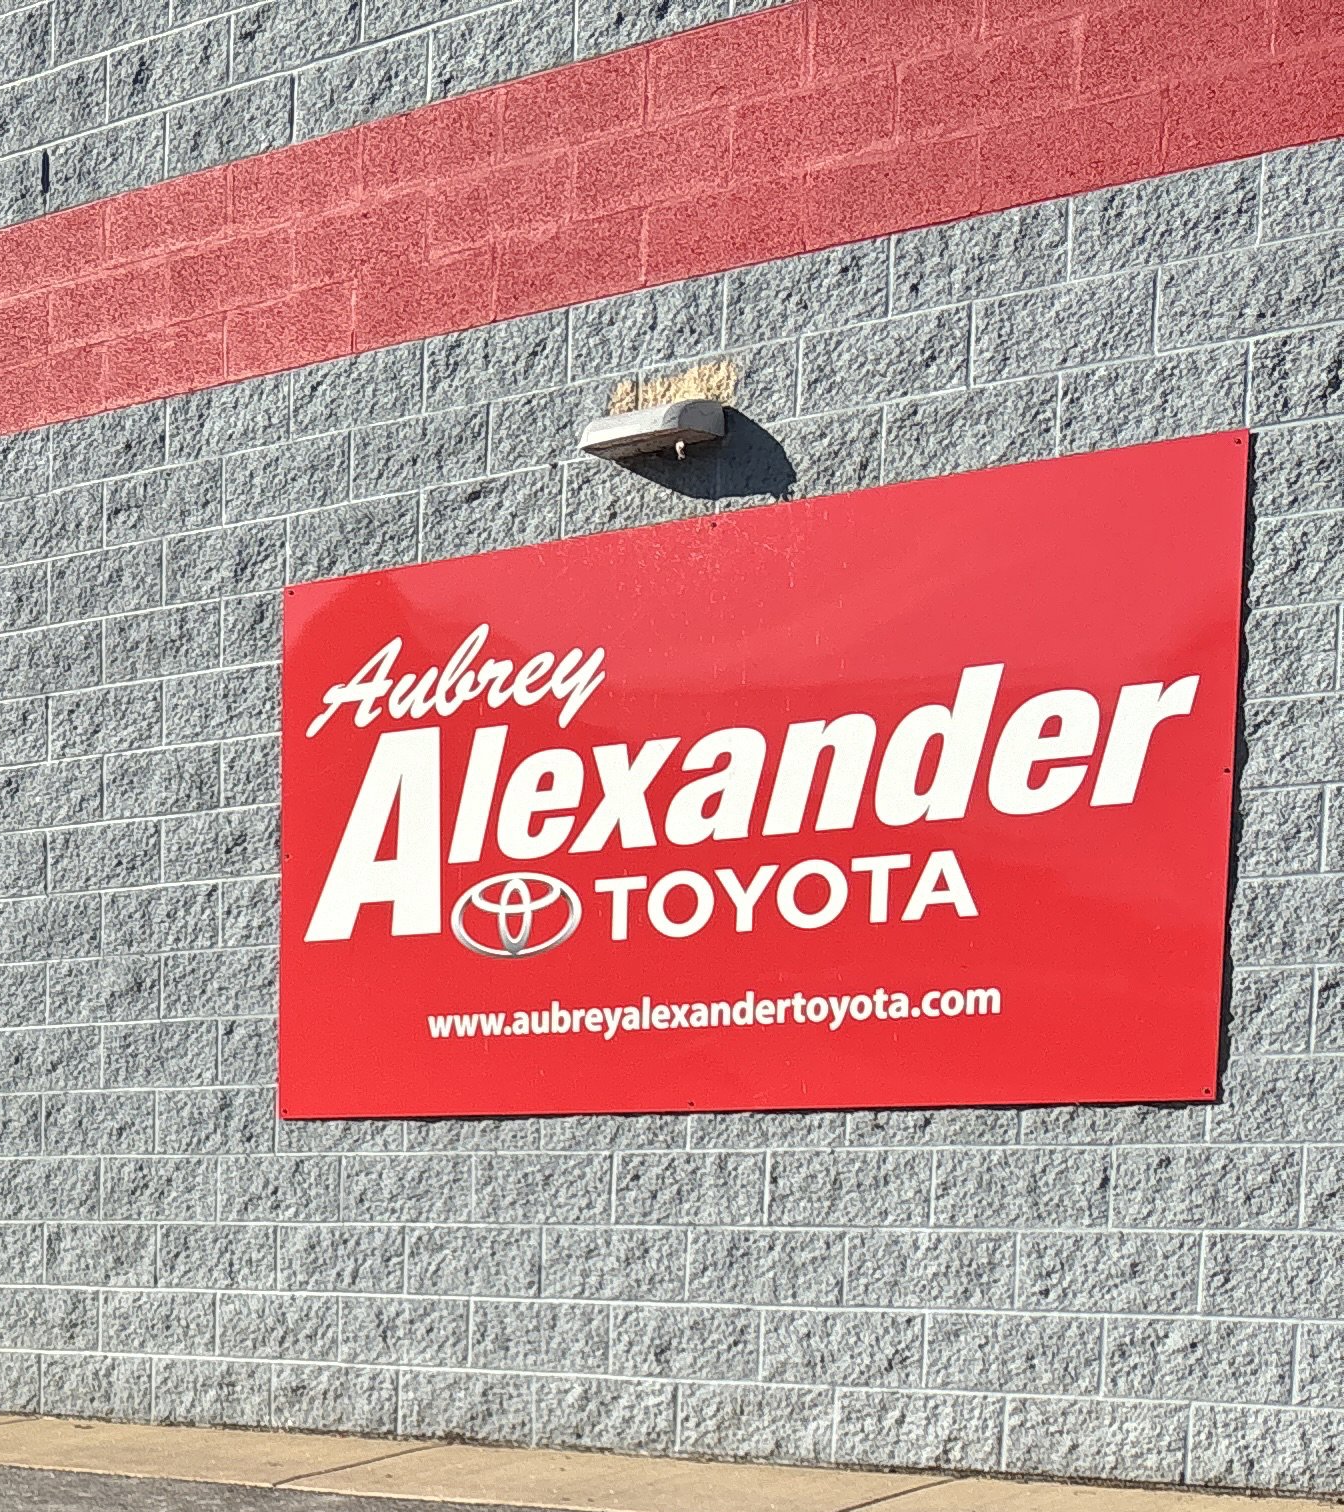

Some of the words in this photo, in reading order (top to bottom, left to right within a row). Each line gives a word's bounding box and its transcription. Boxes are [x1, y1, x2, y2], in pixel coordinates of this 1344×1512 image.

[304, 622, 606, 739] Aubrey
[302, 662, 1200, 943] Alexander
[594, 850, 980, 942] TOYOTA
[426, 986, 1002, 1041] www.aubreyalexandertoyota.com
